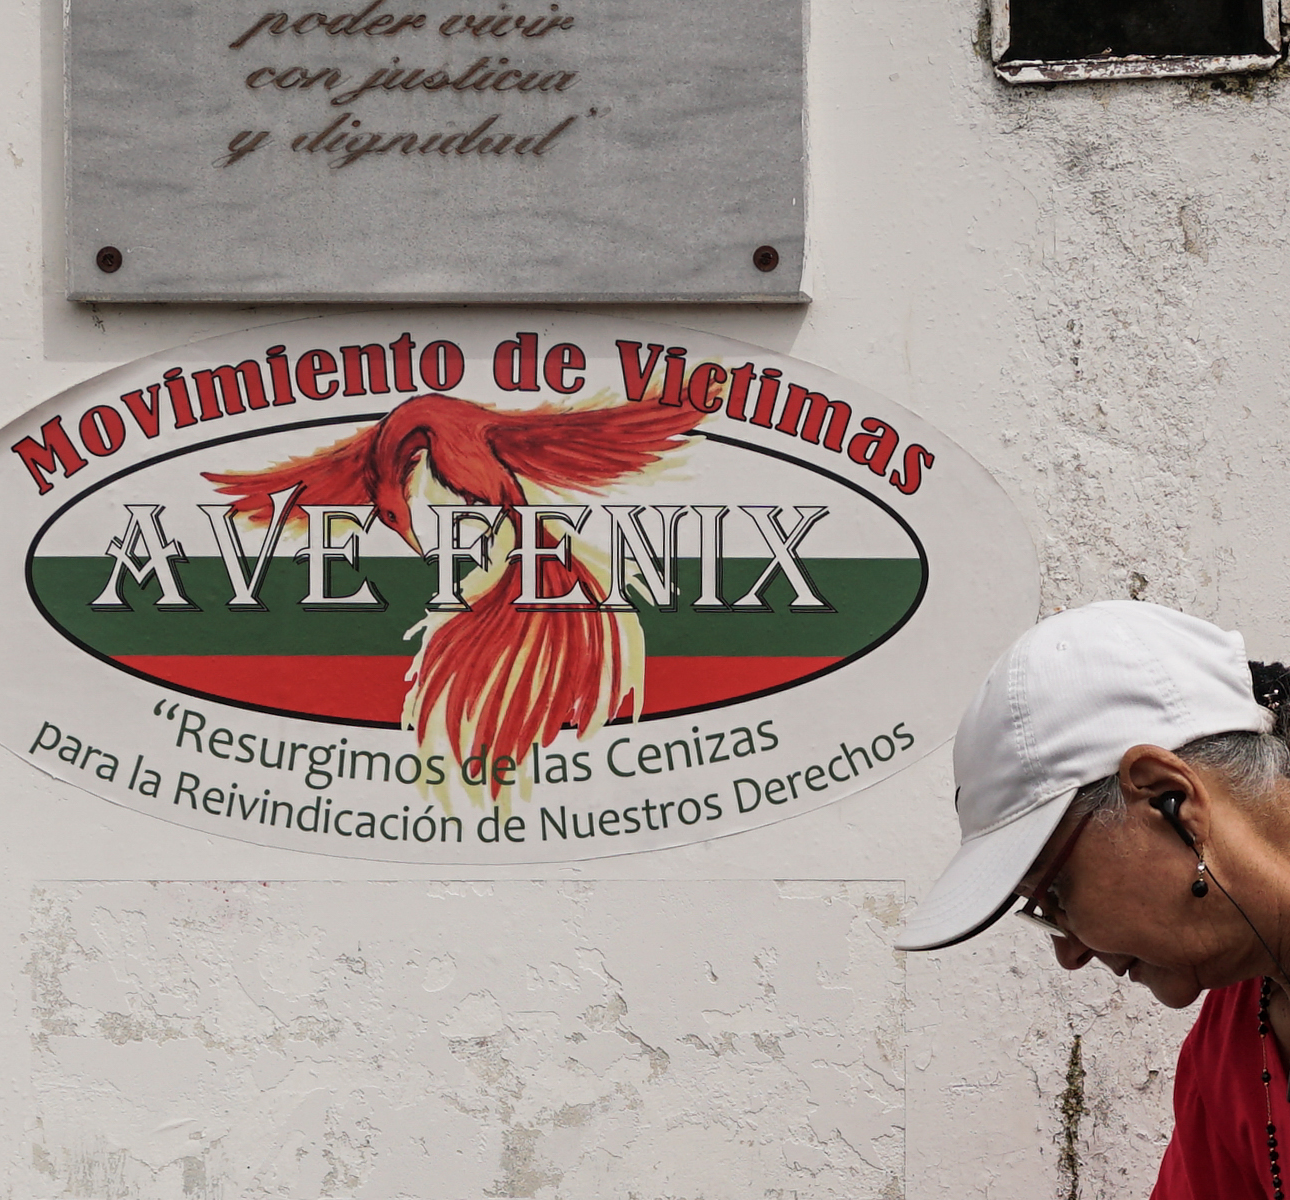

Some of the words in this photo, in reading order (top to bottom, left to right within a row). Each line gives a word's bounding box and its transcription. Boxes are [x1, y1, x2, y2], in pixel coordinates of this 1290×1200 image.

[228, 0, 427, 49] poder
[439, 2, 575, 38] vivir
[245, 65, 347, 92] con
[331, 56, 581, 106] justicia
[212, 131, 273, 168] y
[12, 332, 464, 495] Movimiento
[493, 332, 586, 394] de
[615, 340, 935, 495] Victimas
[89, 484, 389, 614] AVE
[425, 504, 838, 614] FENIX
[29, 721, 119, 782] para
[128, 755, 162, 798] la
[173, 772, 463, 843] Reivindicación
[477, 805, 525, 843] de
[541, 792, 722, 842] Nuestros
[733, 721, 915, 814] Derechos
[153, 698, 446, 790] “Resurgimos
[462, 743, 516, 786] de
[532, 743, 592, 785] las
[606, 719, 779, 778] Cenizas
